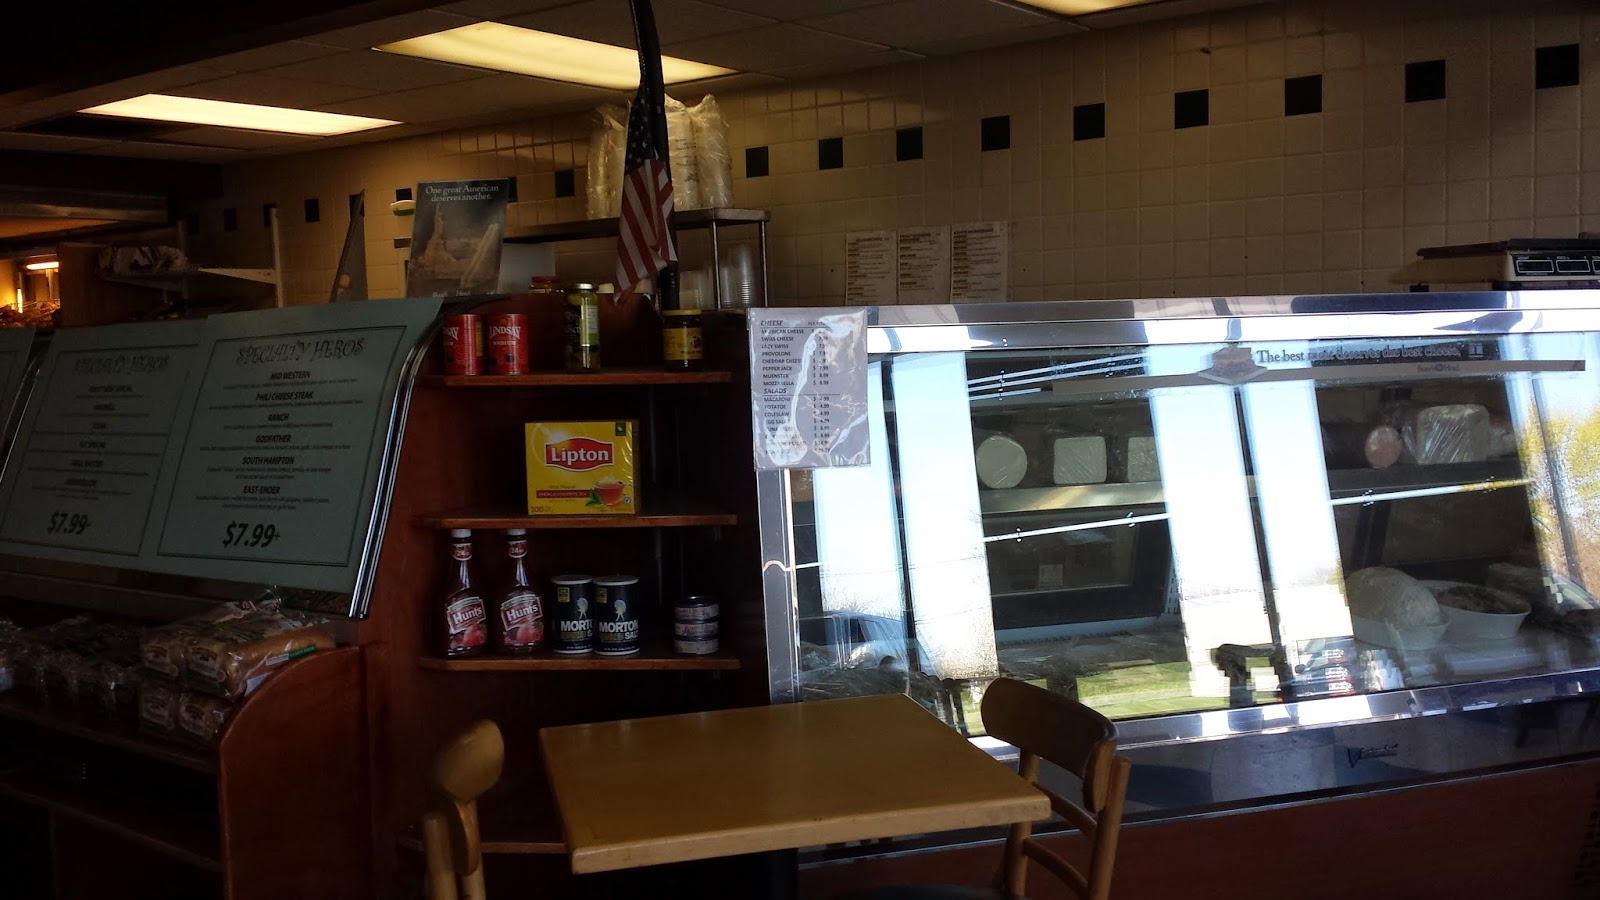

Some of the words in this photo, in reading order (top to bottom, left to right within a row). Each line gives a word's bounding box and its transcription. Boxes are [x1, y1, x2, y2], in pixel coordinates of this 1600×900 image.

[425, 186, 441, 195] One
[443, 186, 461, 198] great
[462, 183, 499, 194] American
[431, 194, 461, 202] deserves
[462, 192, 492, 201] another.
[310, 337, 365, 362] HEROS
[1257, 349, 1281, 363] The
[1283, 349, 1305, 362] best
[283, 370, 311, 380] WESTERN
[272, 392, 294, 400] CHEESE
[294, 391, 313, 400] STEAK
[268, 413, 289, 422] RANCH
[255, 434, 291, 443] GODFATHER
[242, 456, 263, 465] SOUTH
[264, 456, 295, 465] HAMPTON
[551, 447, 610, 466] Lipton
[599, 619, 639, 633] MORTON
